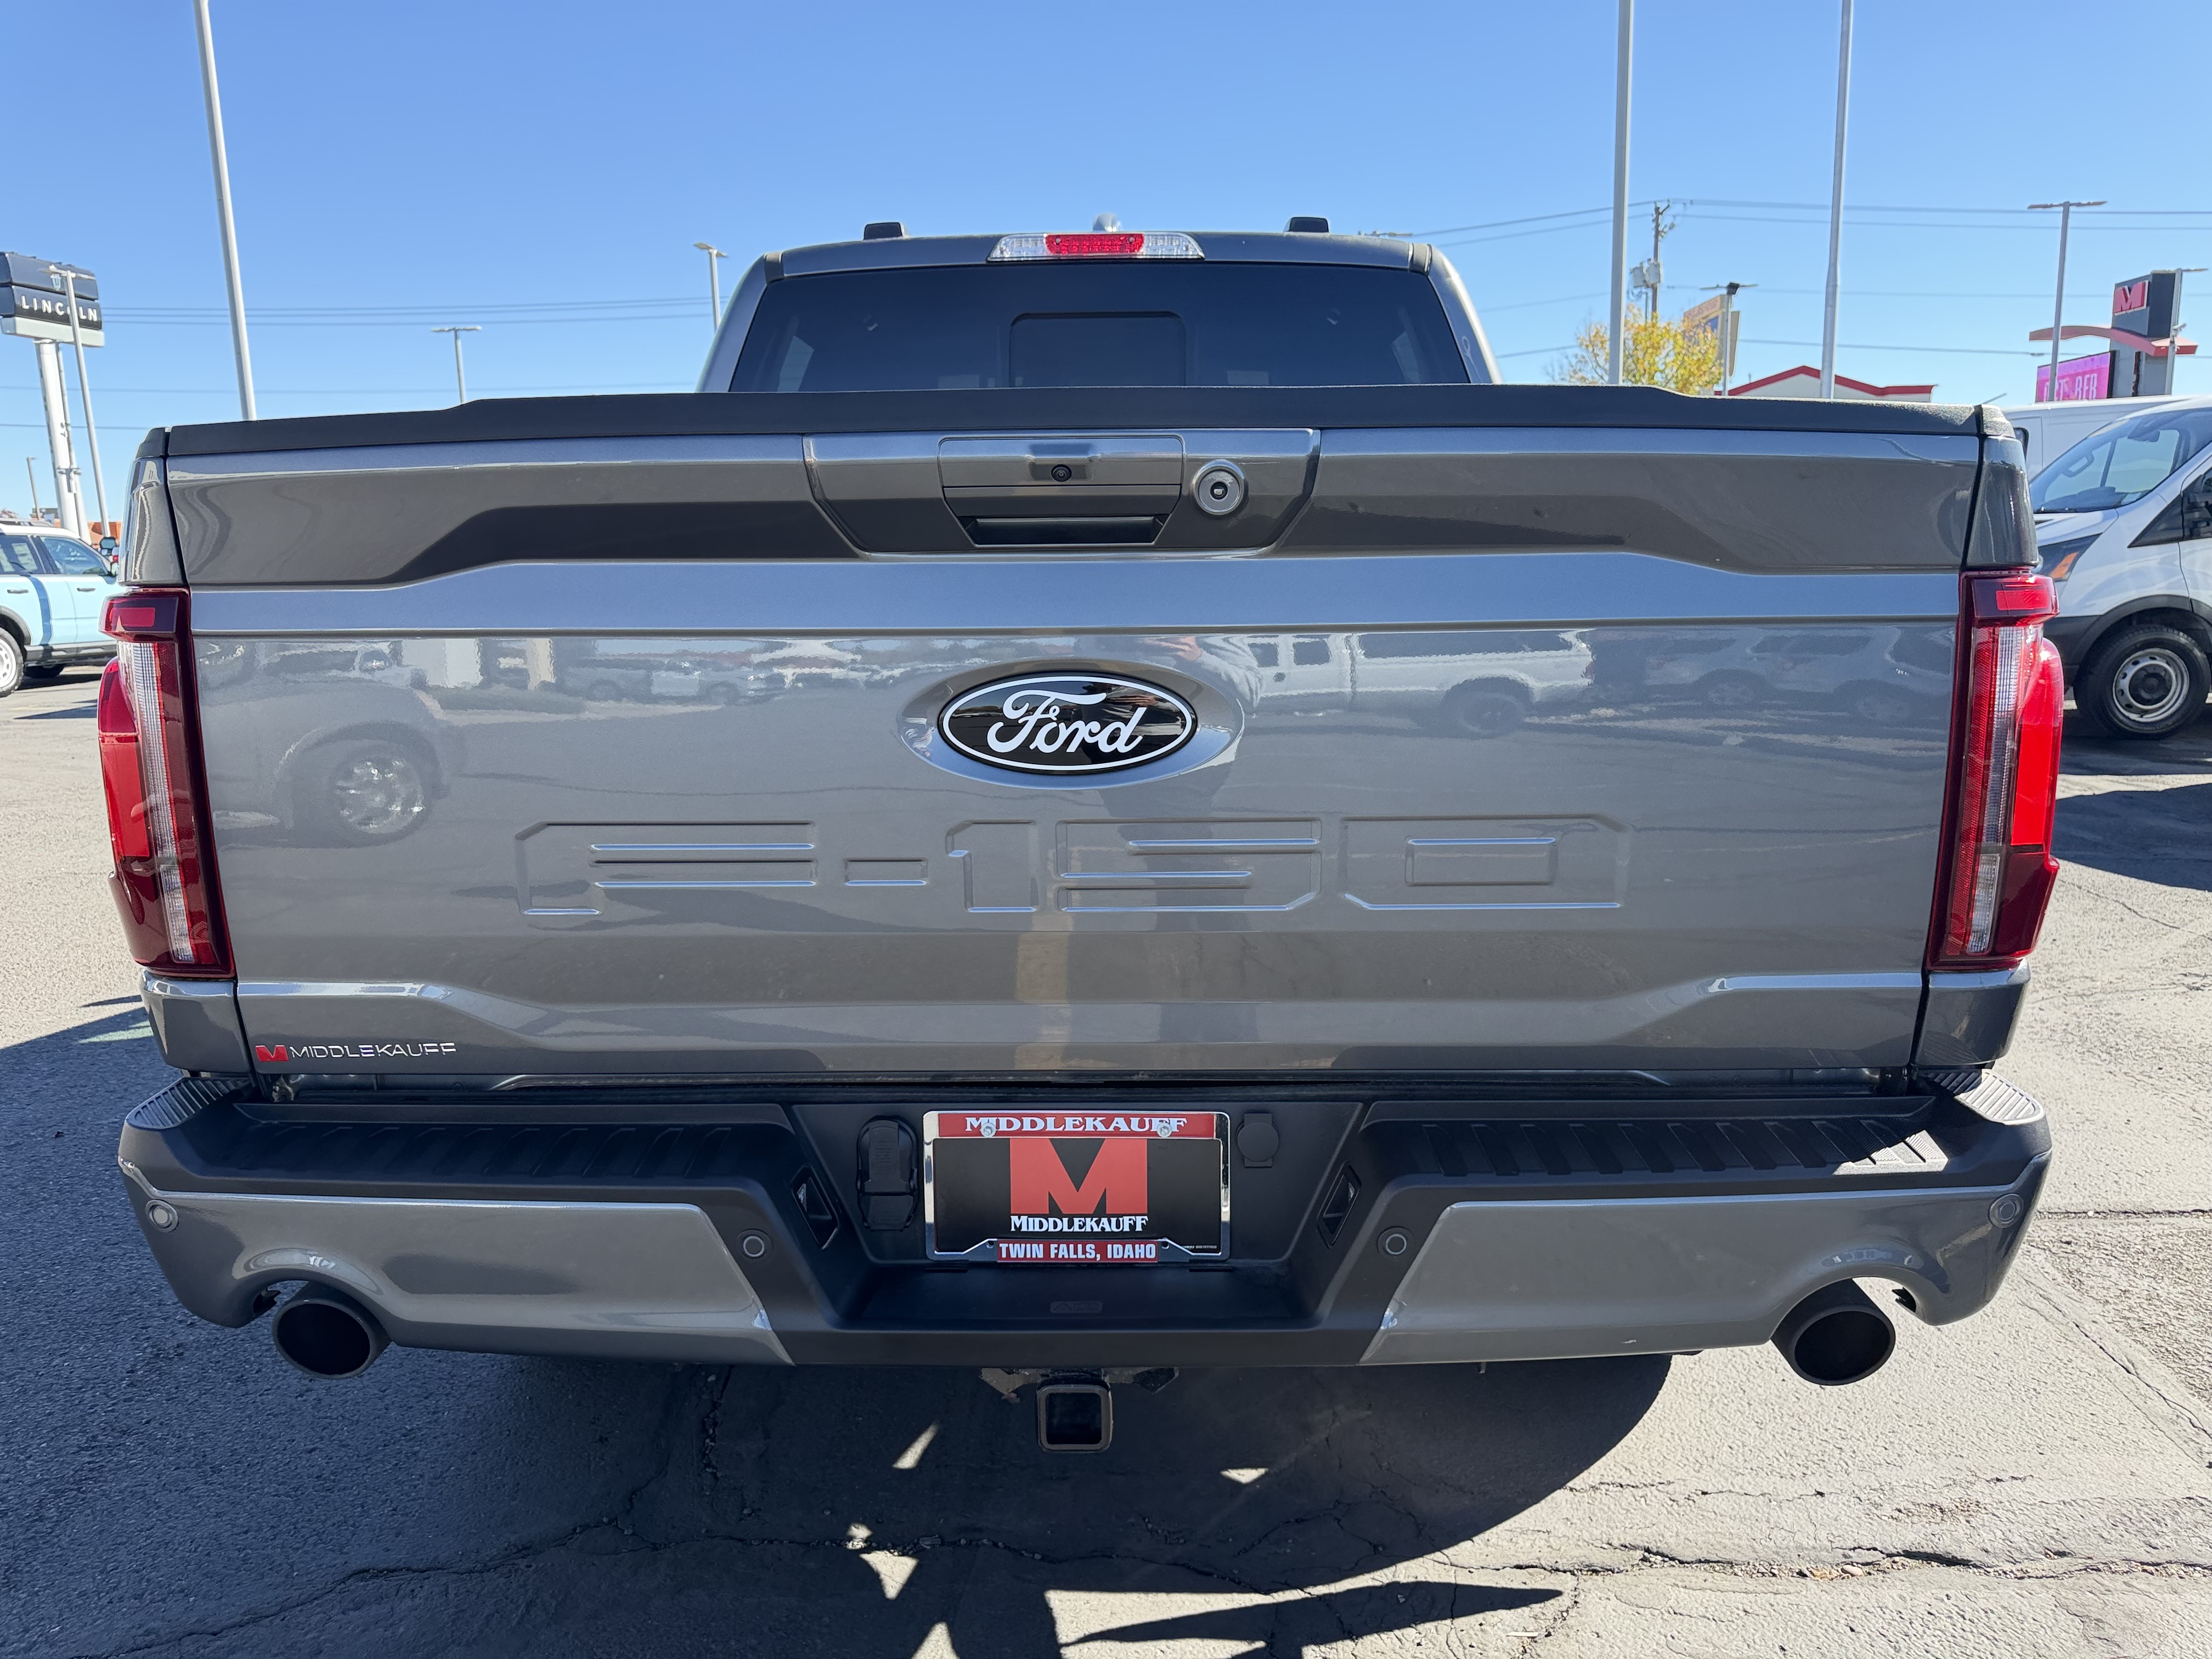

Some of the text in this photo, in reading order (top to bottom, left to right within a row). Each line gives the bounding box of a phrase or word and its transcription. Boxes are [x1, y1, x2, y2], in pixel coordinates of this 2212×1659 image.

[987, 690, 1147, 753] Ford
[516, 814, 1630, 915] F-150
[290, 1042, 457, 1058] MIDDLEKAUFF
[1009, 1138, 1148, 1214] M
[1000, 1243, 1156, 1261] TWIN FALLS, IDAHO
